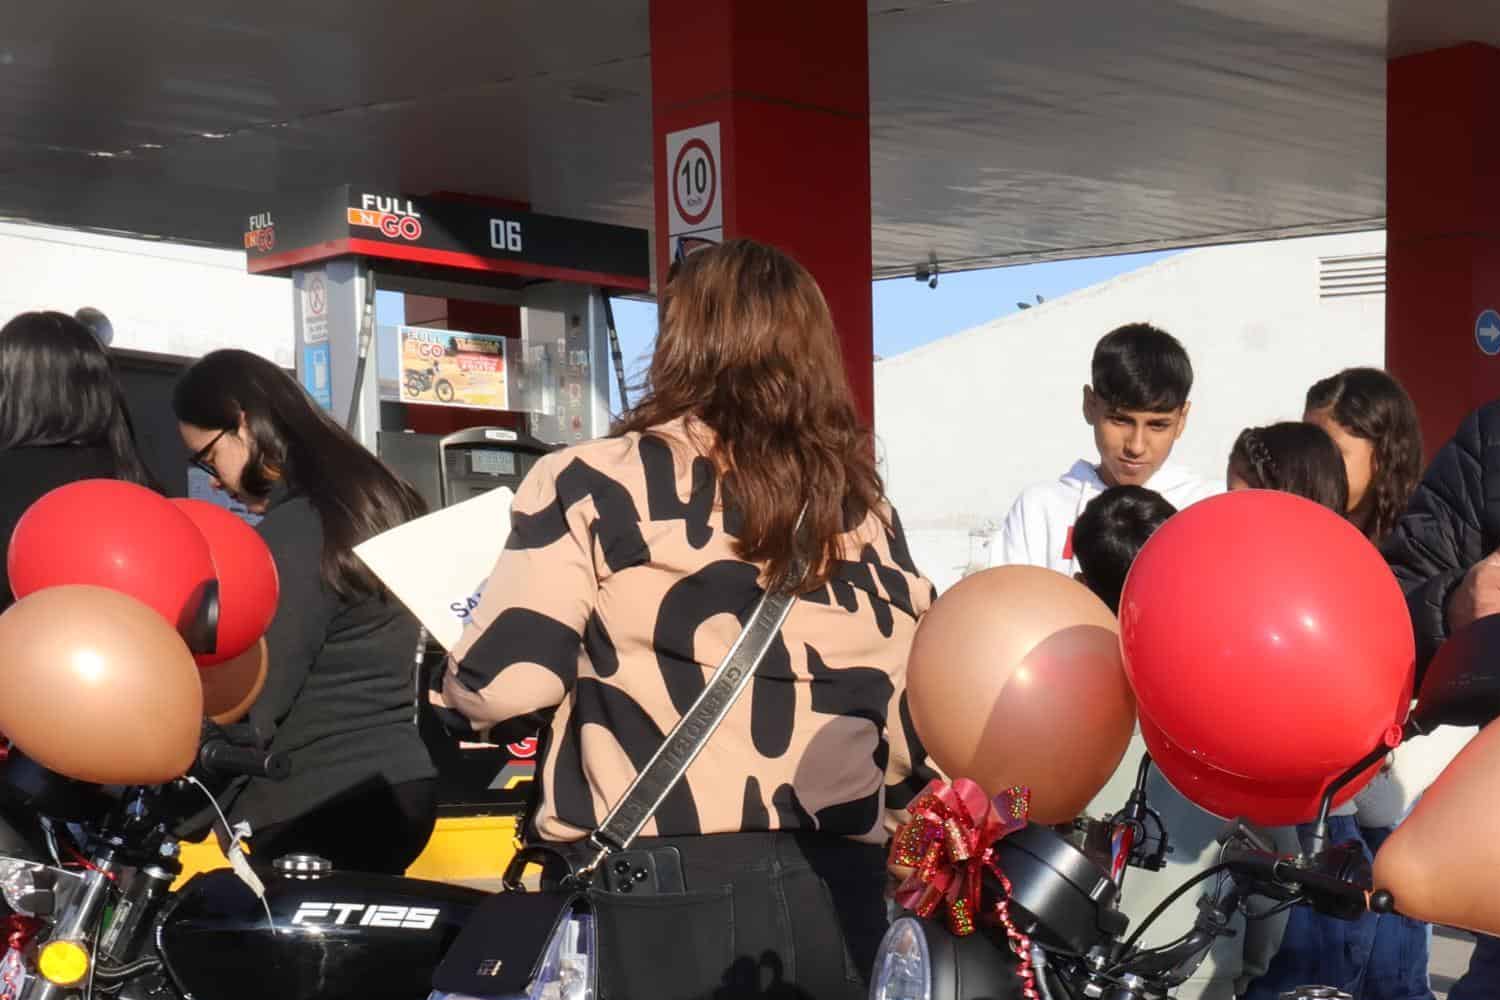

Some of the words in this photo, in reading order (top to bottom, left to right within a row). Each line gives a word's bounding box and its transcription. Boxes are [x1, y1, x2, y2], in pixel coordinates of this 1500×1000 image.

[681, 157, 706, 195] 10
[362, 193, 421, 217] FULL
[380, 213, 422, 240] GO
[489, 218, 522, 251] 06
[291, 902, 440, 929] FT125
